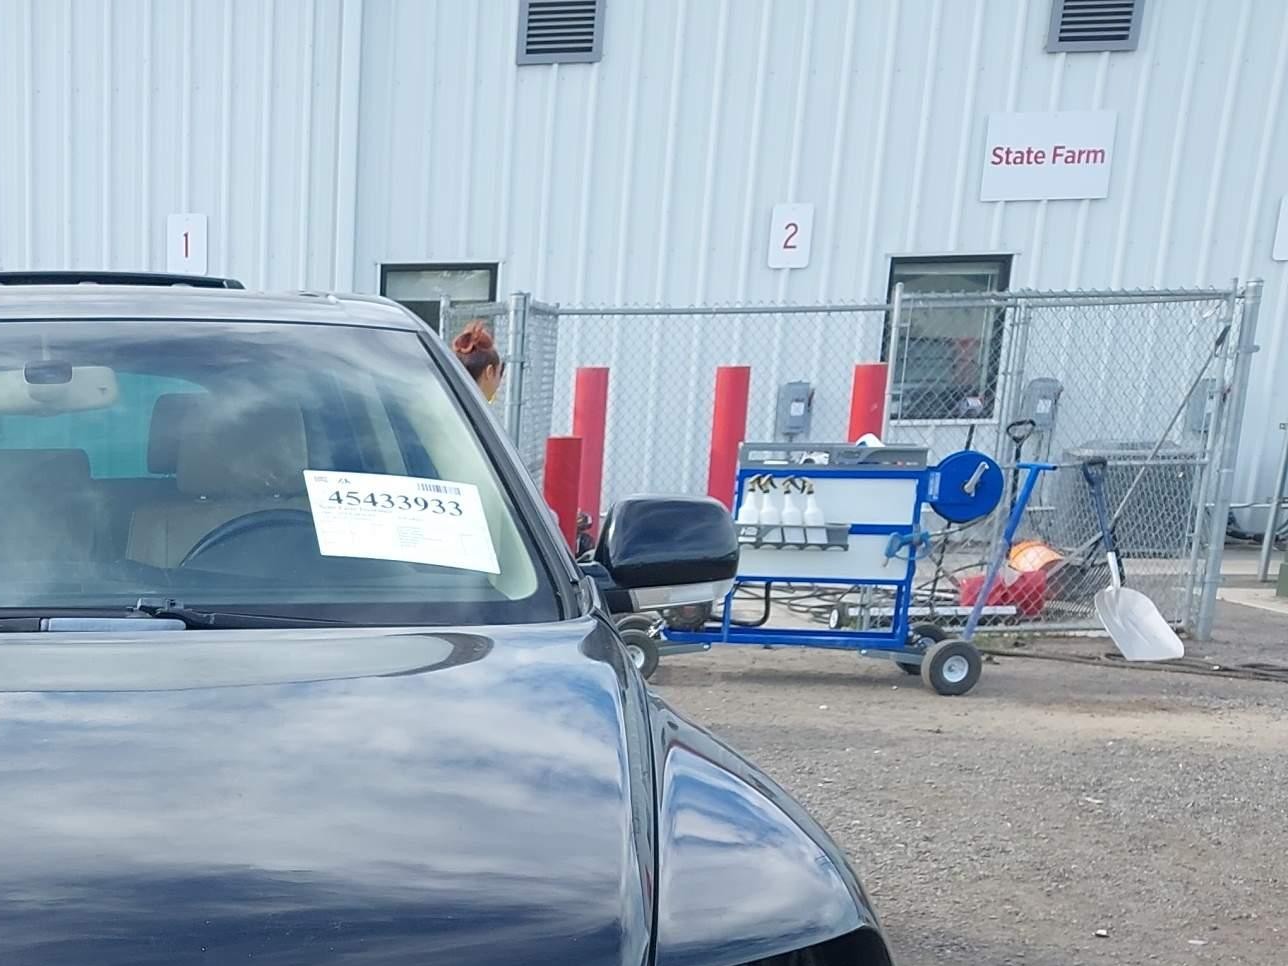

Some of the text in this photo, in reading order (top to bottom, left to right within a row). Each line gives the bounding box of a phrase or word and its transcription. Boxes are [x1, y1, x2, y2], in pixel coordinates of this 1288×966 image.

[990, 145, 1105, 166] State Farm
[783, 223, 799, 249] 2
[328, 490, 463, 517] 45433933
